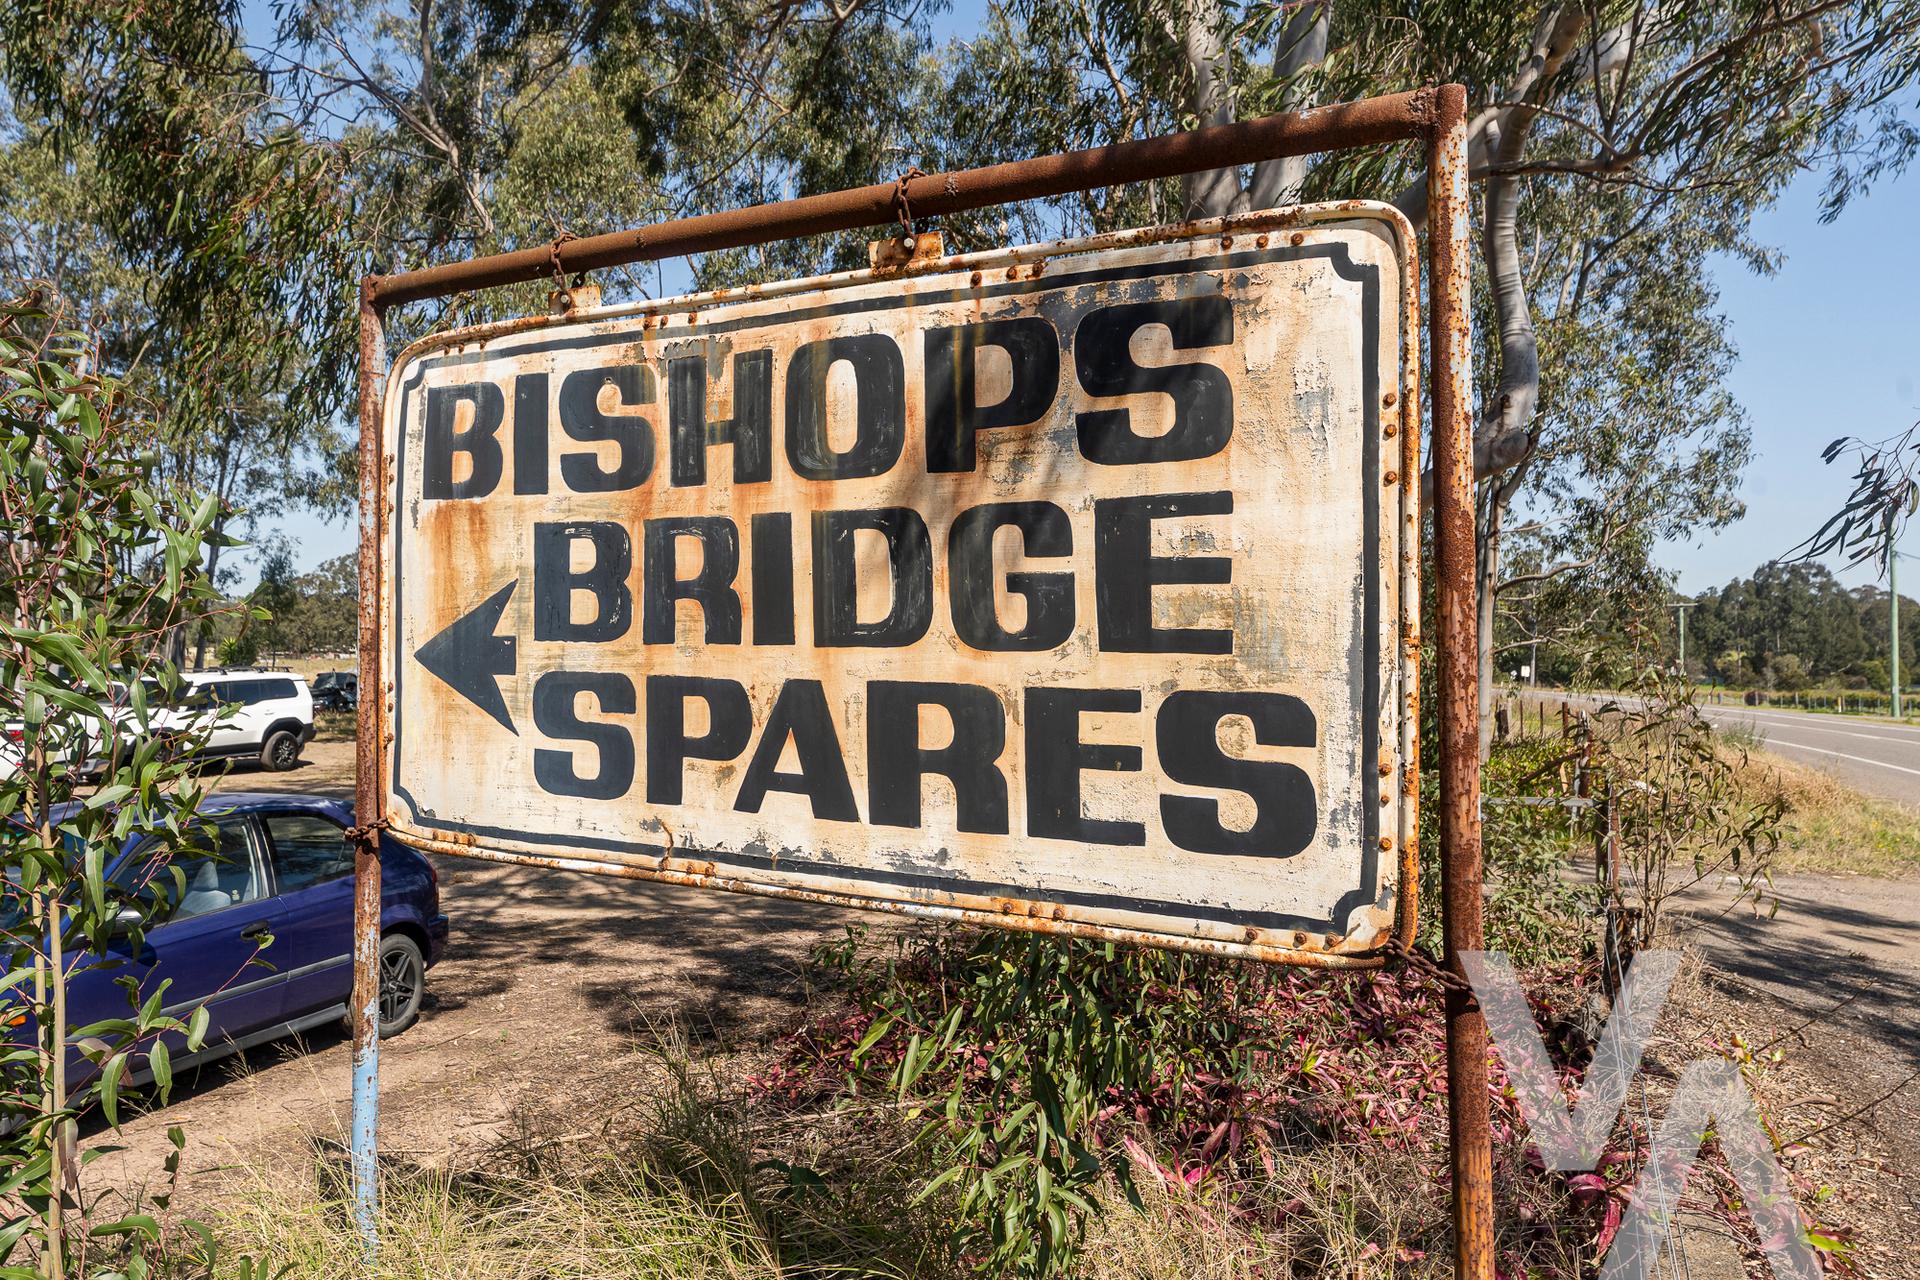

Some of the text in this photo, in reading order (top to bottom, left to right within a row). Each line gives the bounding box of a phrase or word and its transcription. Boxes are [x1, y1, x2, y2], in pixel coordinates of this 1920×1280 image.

[423, 296, 1234, 500] BISHOPS
[533, 490, 1234, 654] BRIDGE
[533, 672, 1318, 858] SPARES
